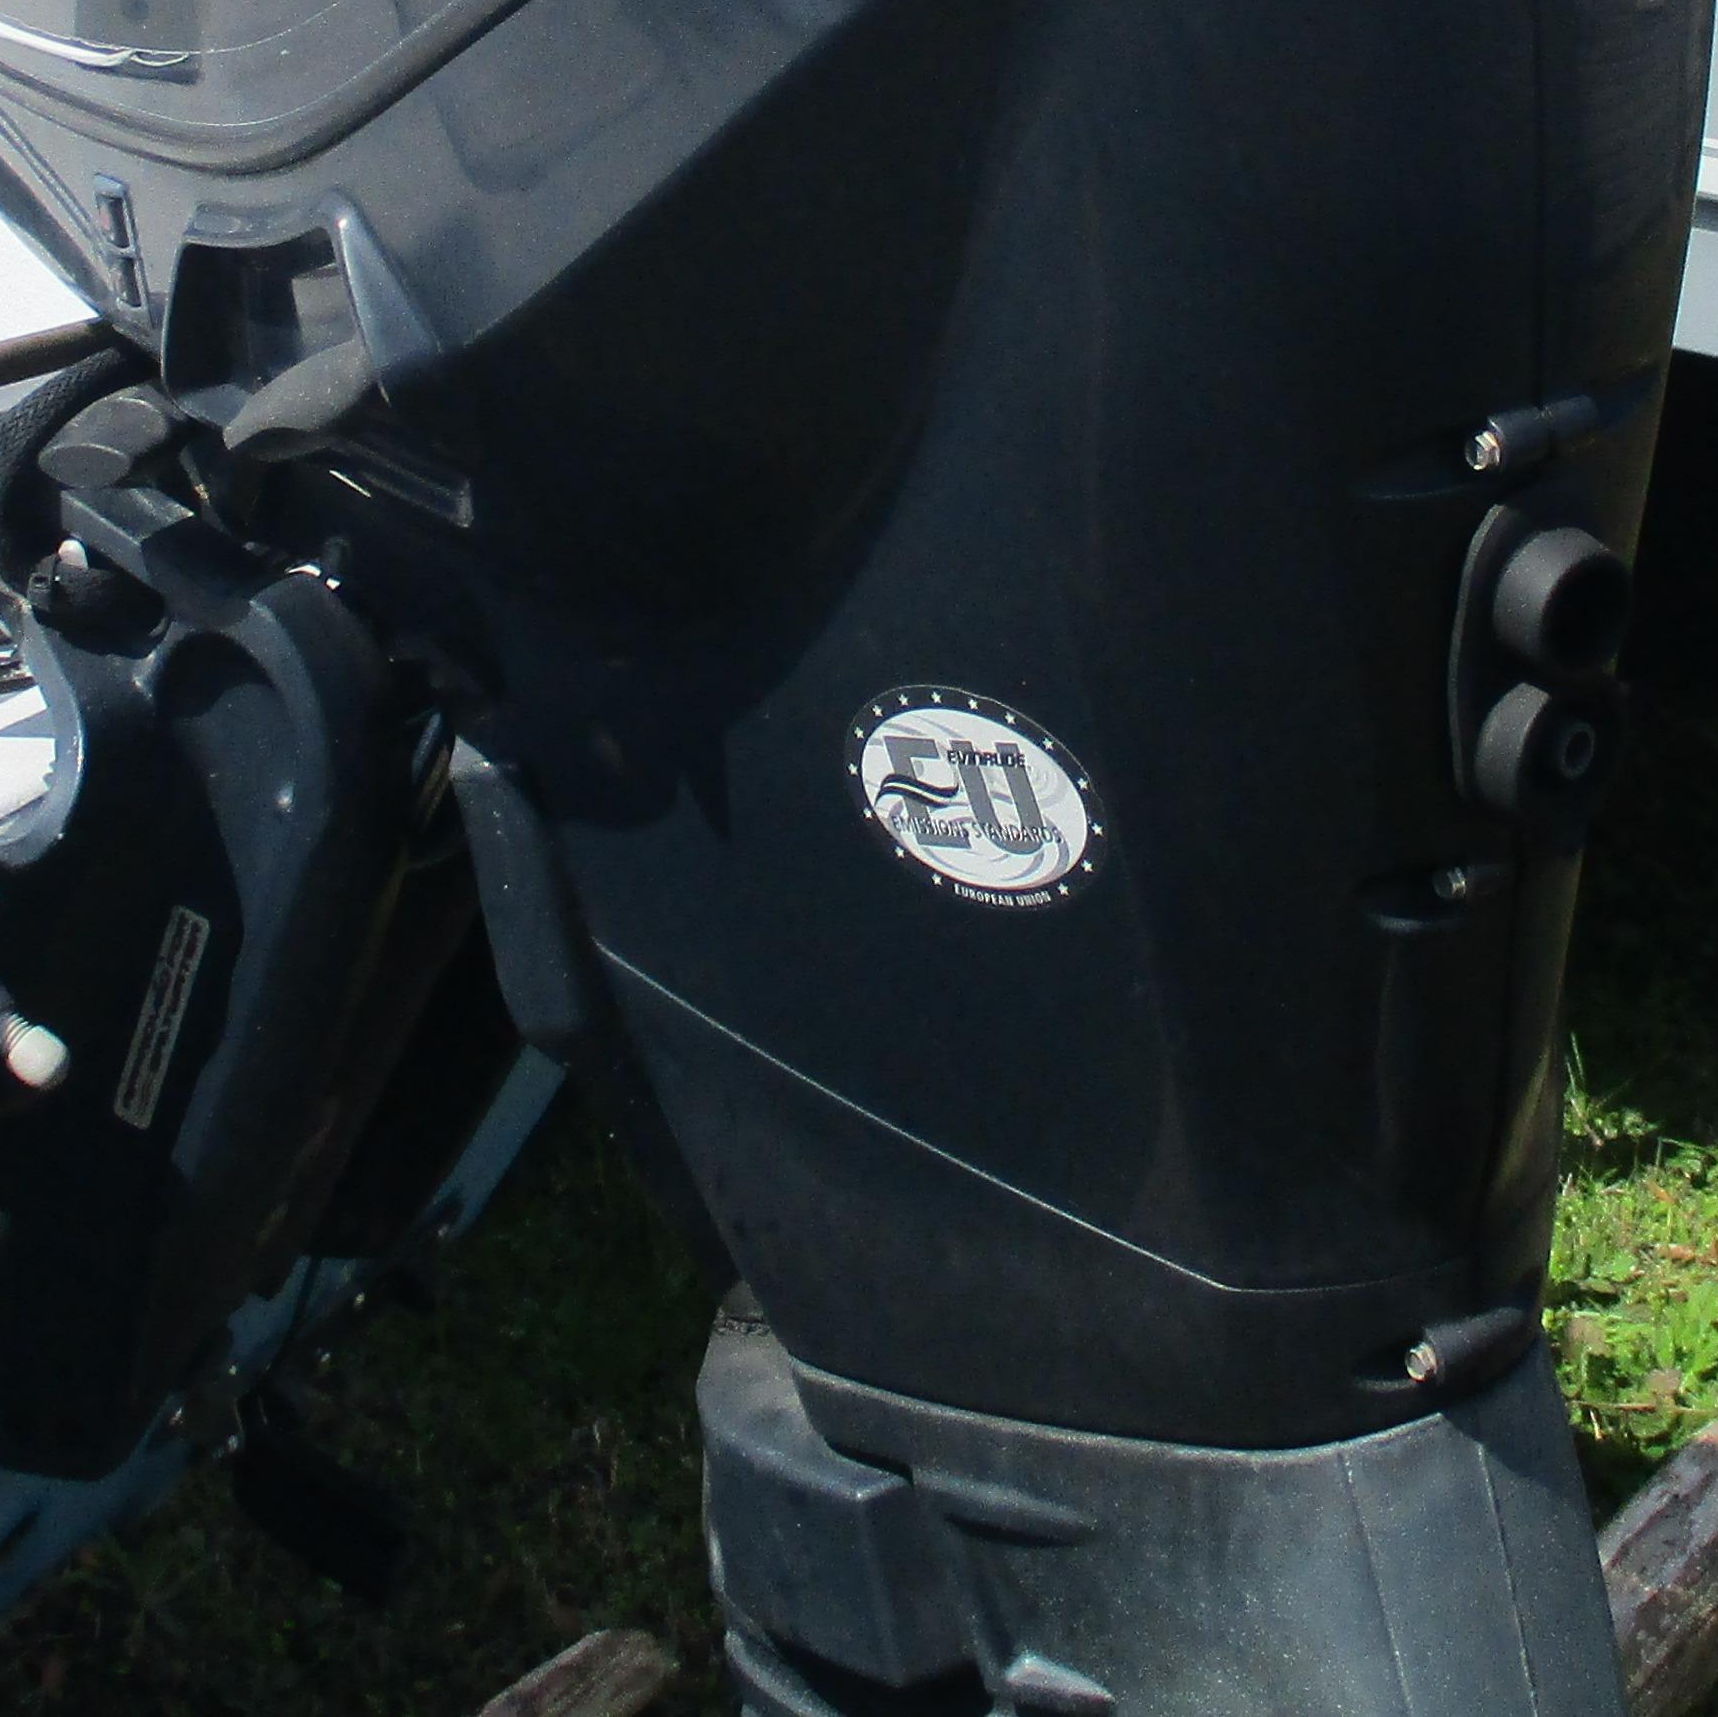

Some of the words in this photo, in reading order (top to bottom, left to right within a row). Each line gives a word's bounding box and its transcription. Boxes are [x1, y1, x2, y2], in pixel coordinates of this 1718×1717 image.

[891, 815, 971, 839] EMISSIONS
[971, 820, 1064, 844] STANDARDS
[954, 883, 1014, 907] EUROPEAN
[1015, 890, 1052, 907] UNION
